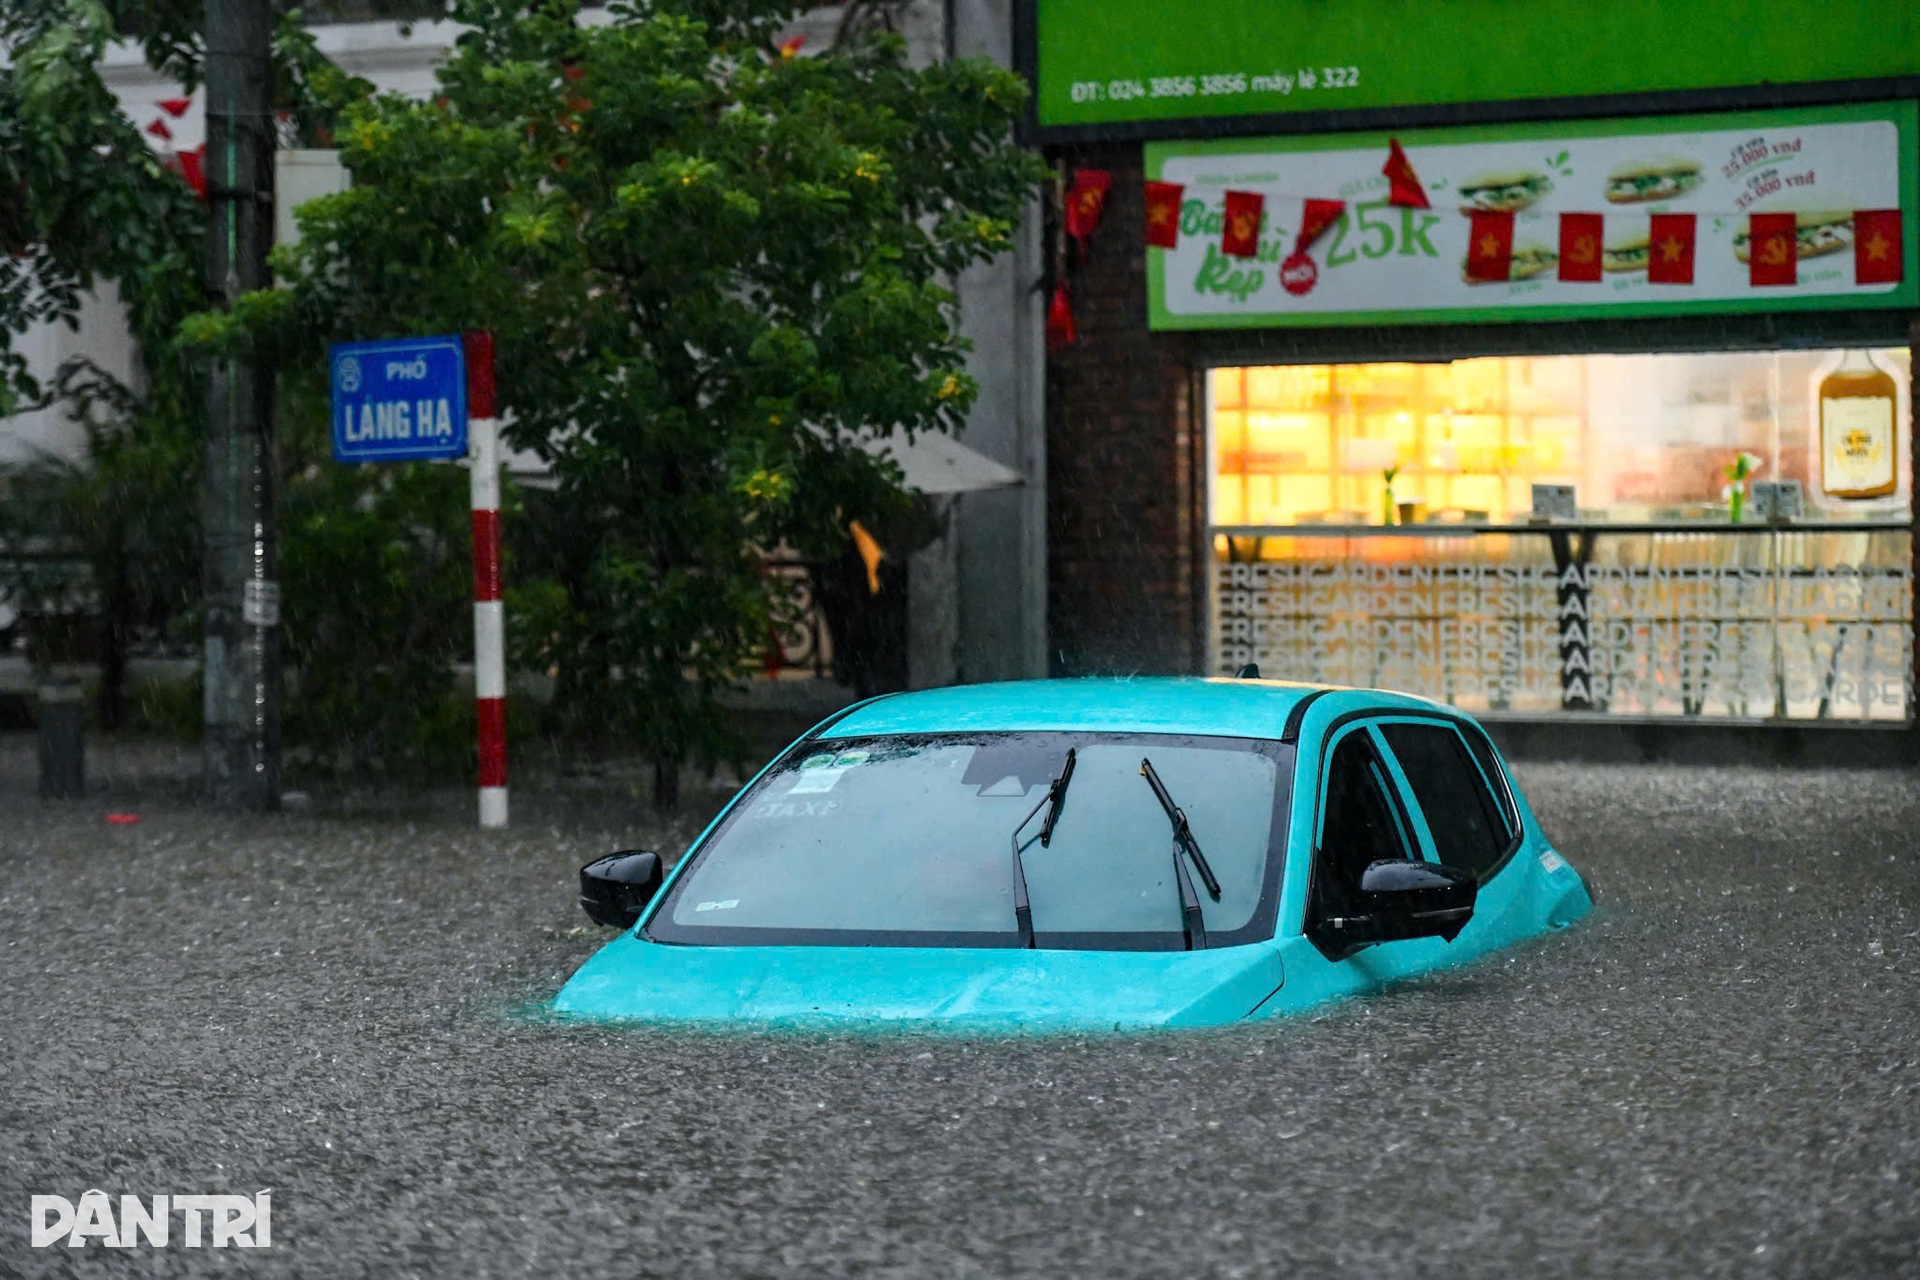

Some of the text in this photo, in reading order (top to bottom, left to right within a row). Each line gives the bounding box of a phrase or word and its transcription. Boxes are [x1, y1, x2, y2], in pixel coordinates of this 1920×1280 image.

[1108, 79, 1145, 100] 024
[1149, 76, 1196, 98] 3856
[1200, 73, 1247, 95] 3856
[1321, 66, 1359, 88] 322
[386, 352, 428, 381] PHỐ
[345, 394, 453, 445] LÁNG HẠ
